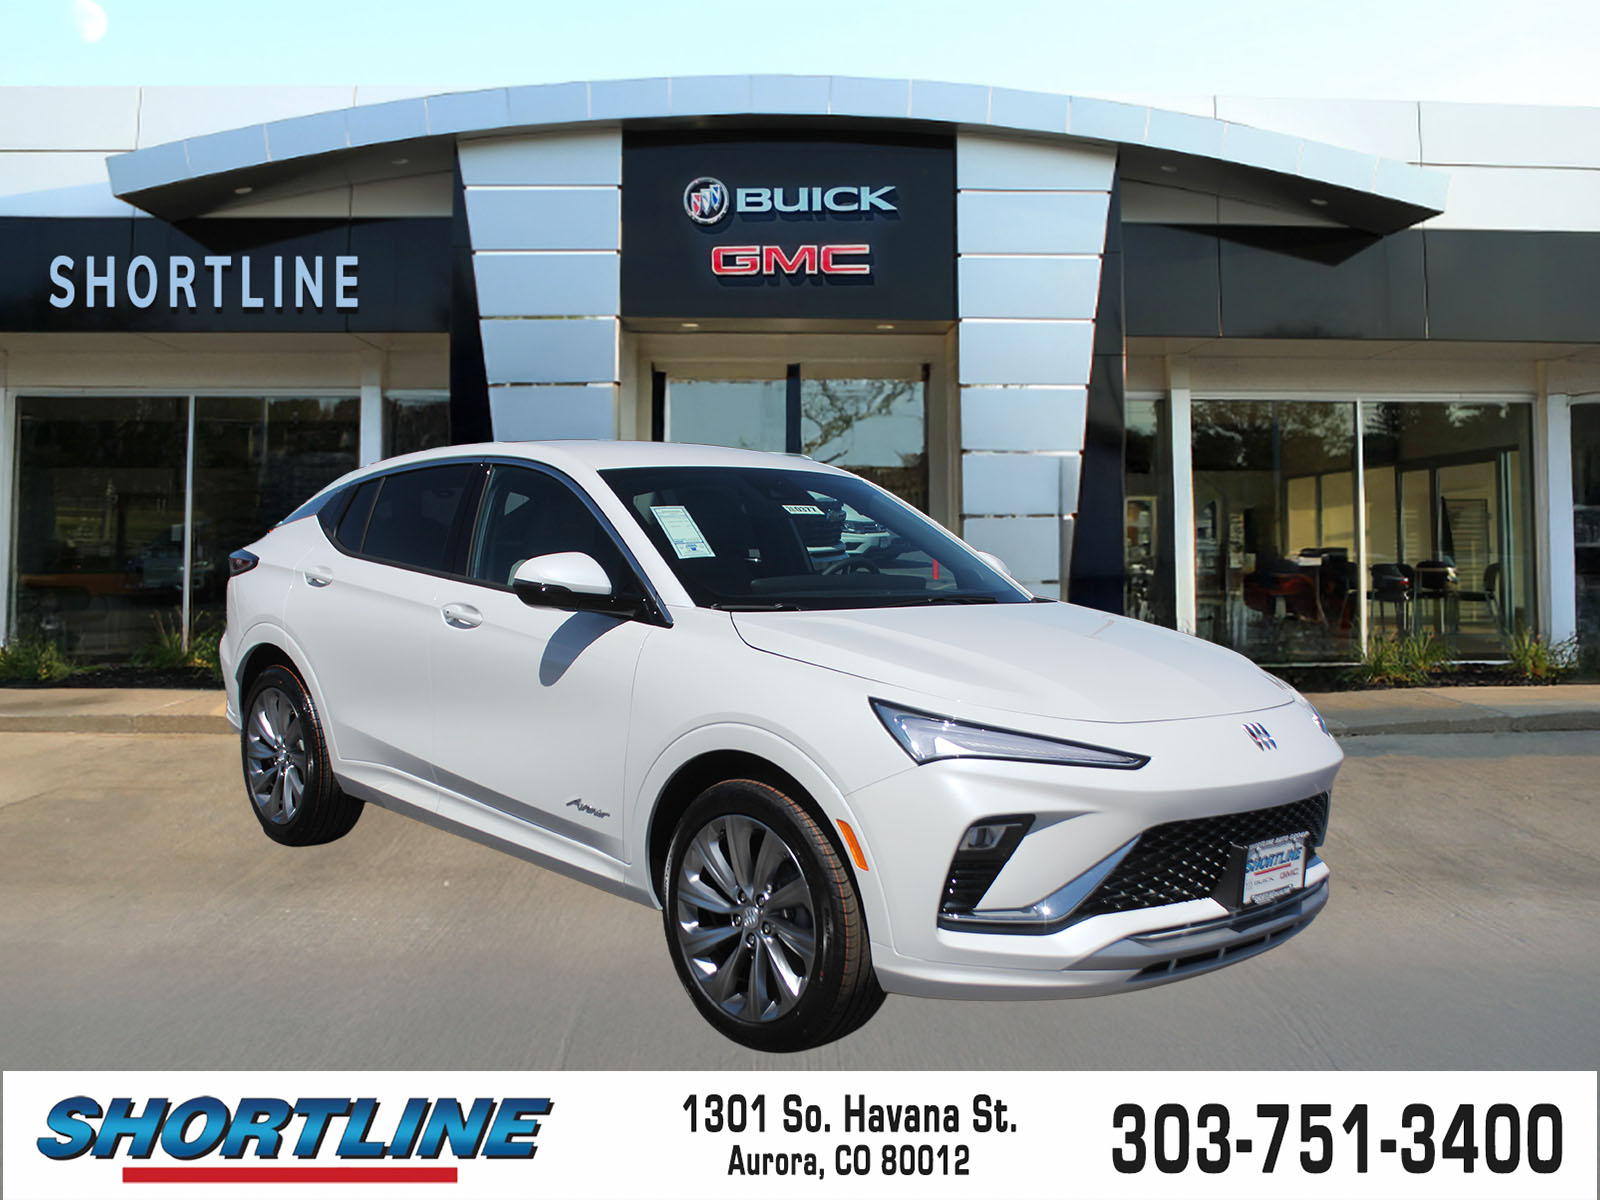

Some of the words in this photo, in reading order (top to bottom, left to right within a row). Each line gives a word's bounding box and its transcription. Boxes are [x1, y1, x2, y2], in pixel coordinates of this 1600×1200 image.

[735, 185, 897, 213] BUICK
[711, 244, 871, 275] GMC
[49, 255, 360, 309] SHORTLINE
